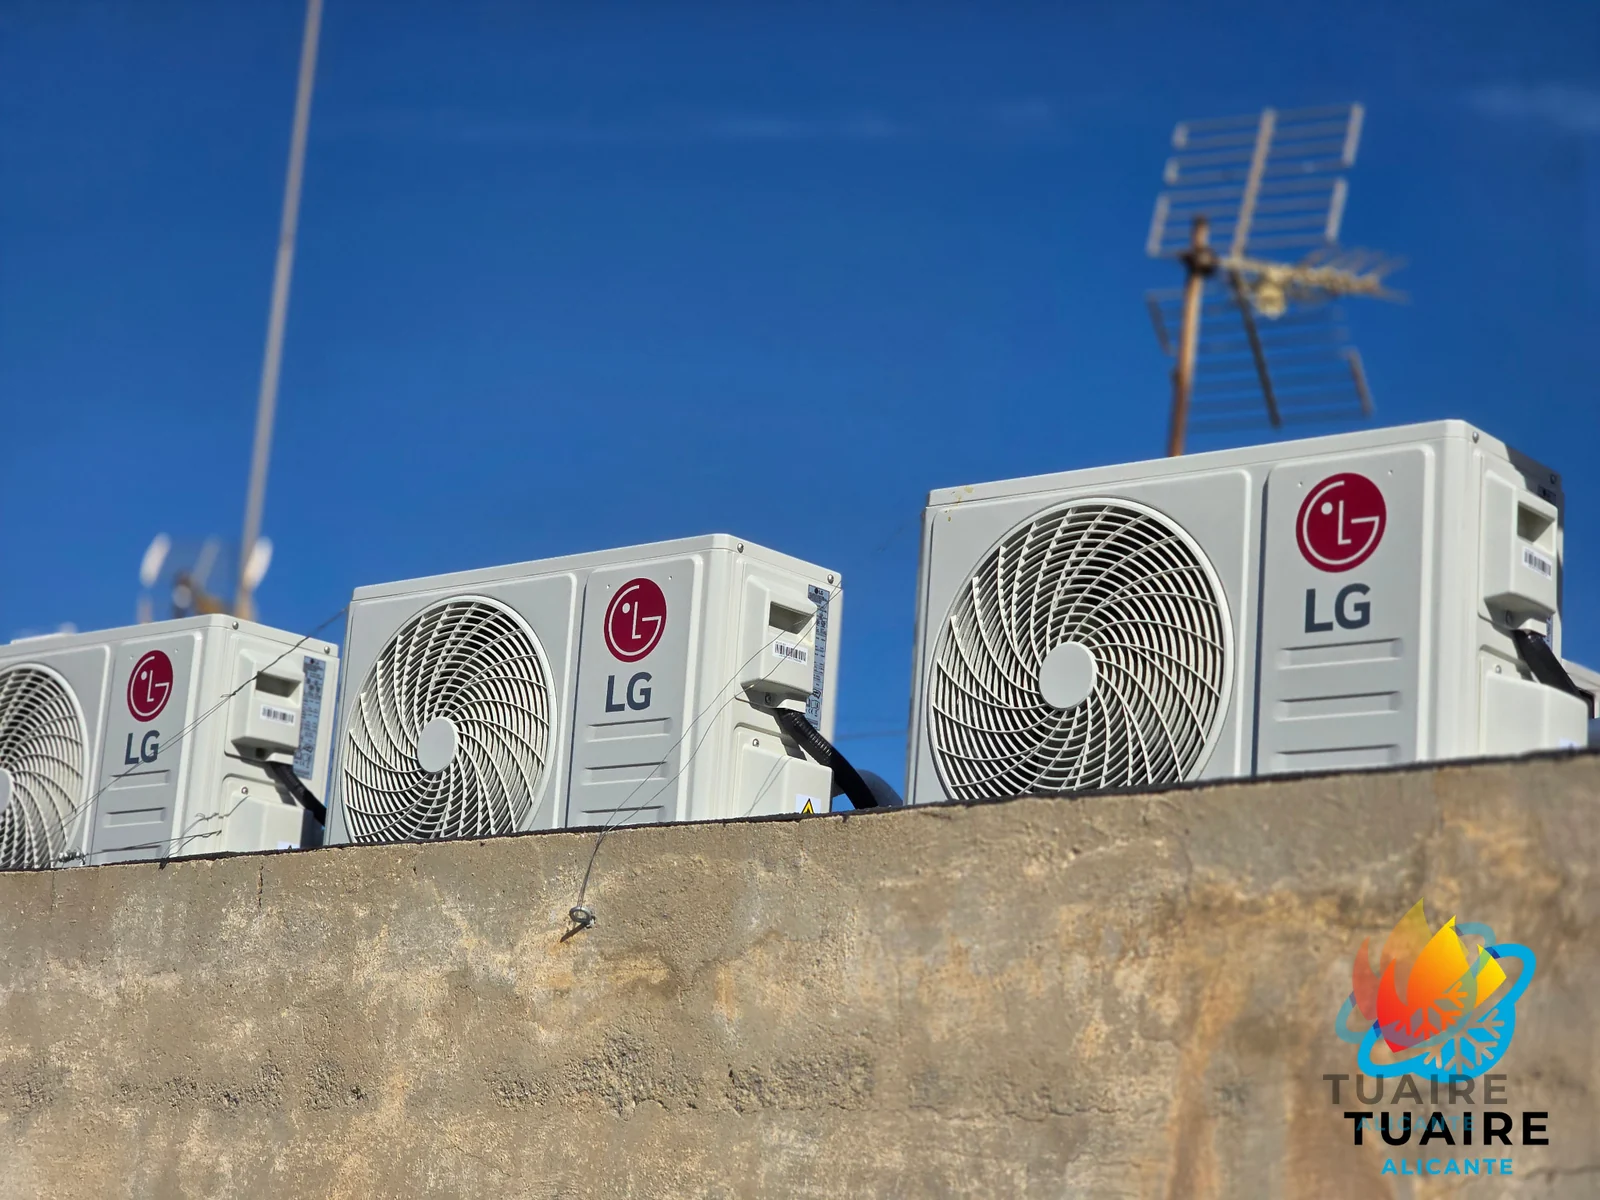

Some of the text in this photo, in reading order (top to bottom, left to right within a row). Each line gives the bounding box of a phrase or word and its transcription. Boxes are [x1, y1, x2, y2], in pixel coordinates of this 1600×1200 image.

[1304, 582, 1371, 634] LG
[605, 671, 653, 713] LG
[124, 729, 160, 766] LG
